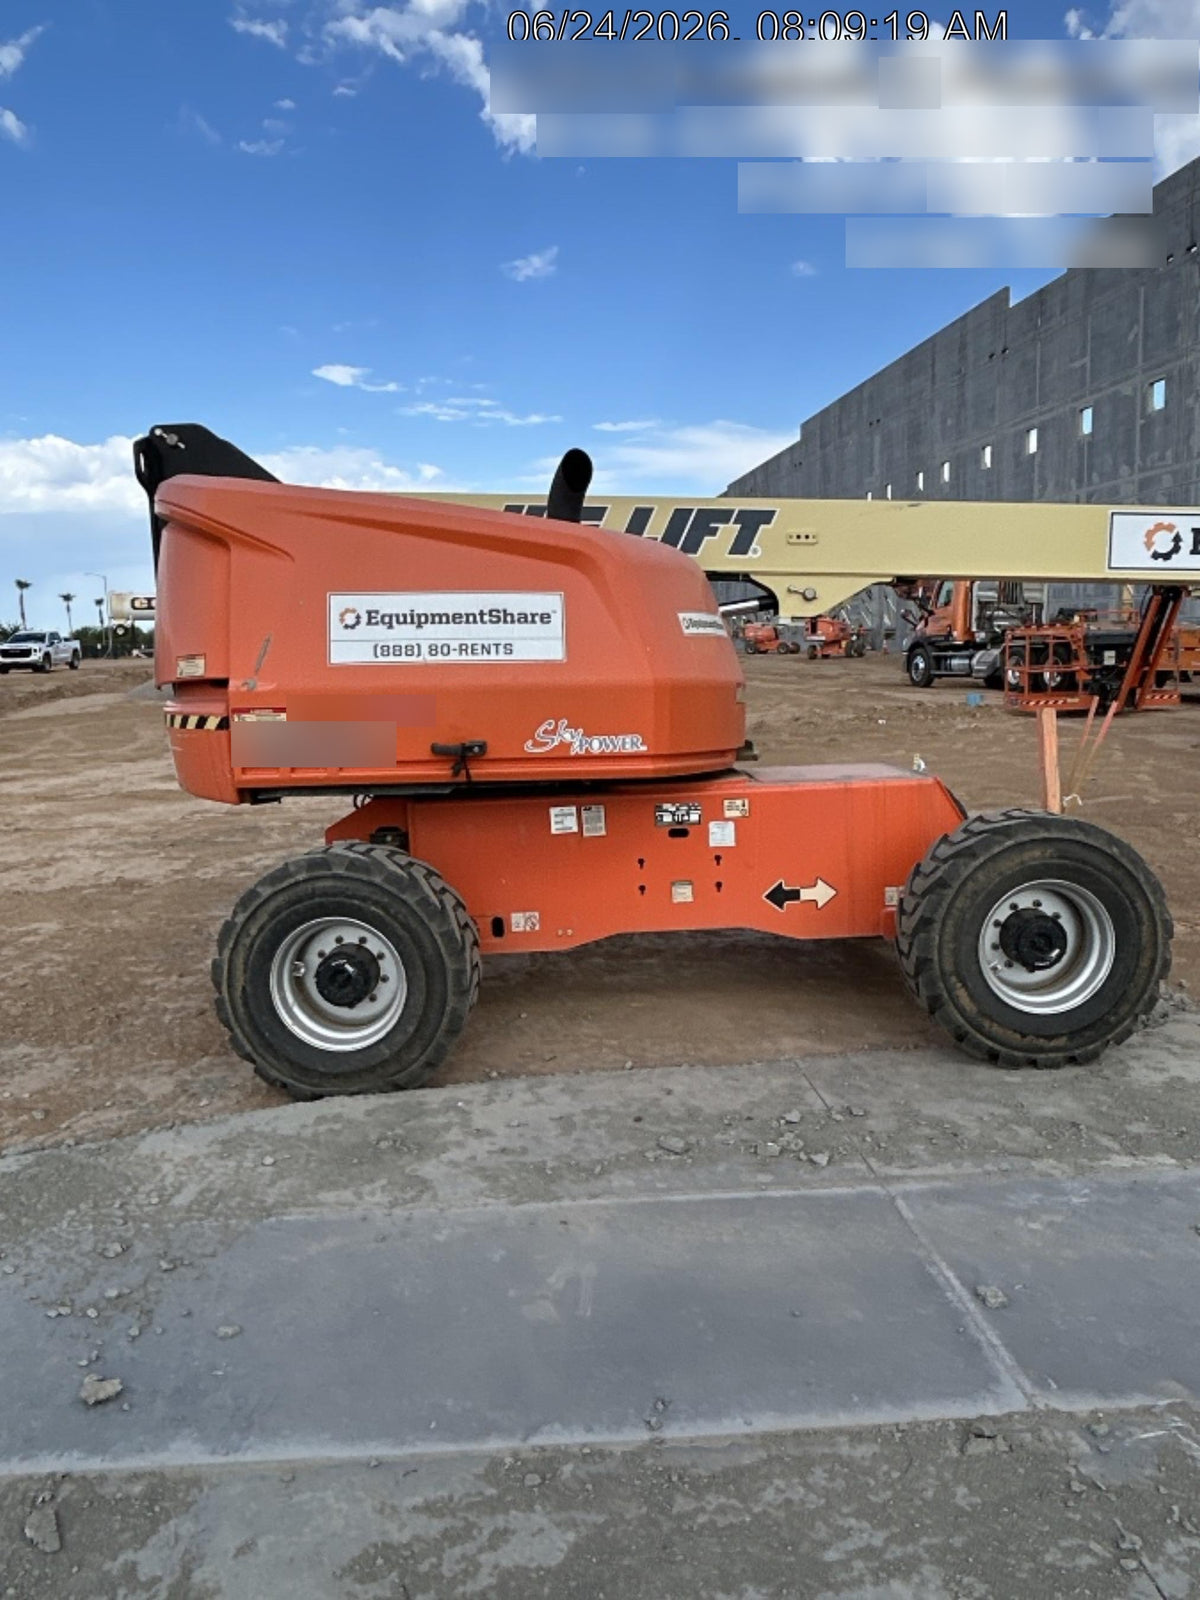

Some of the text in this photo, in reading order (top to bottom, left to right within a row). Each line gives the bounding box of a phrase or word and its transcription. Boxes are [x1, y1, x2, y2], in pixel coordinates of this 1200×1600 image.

[366, 609, 553, 629] EquipmentShare
[373, 643, 513, 658] (888) 80-RENTS
